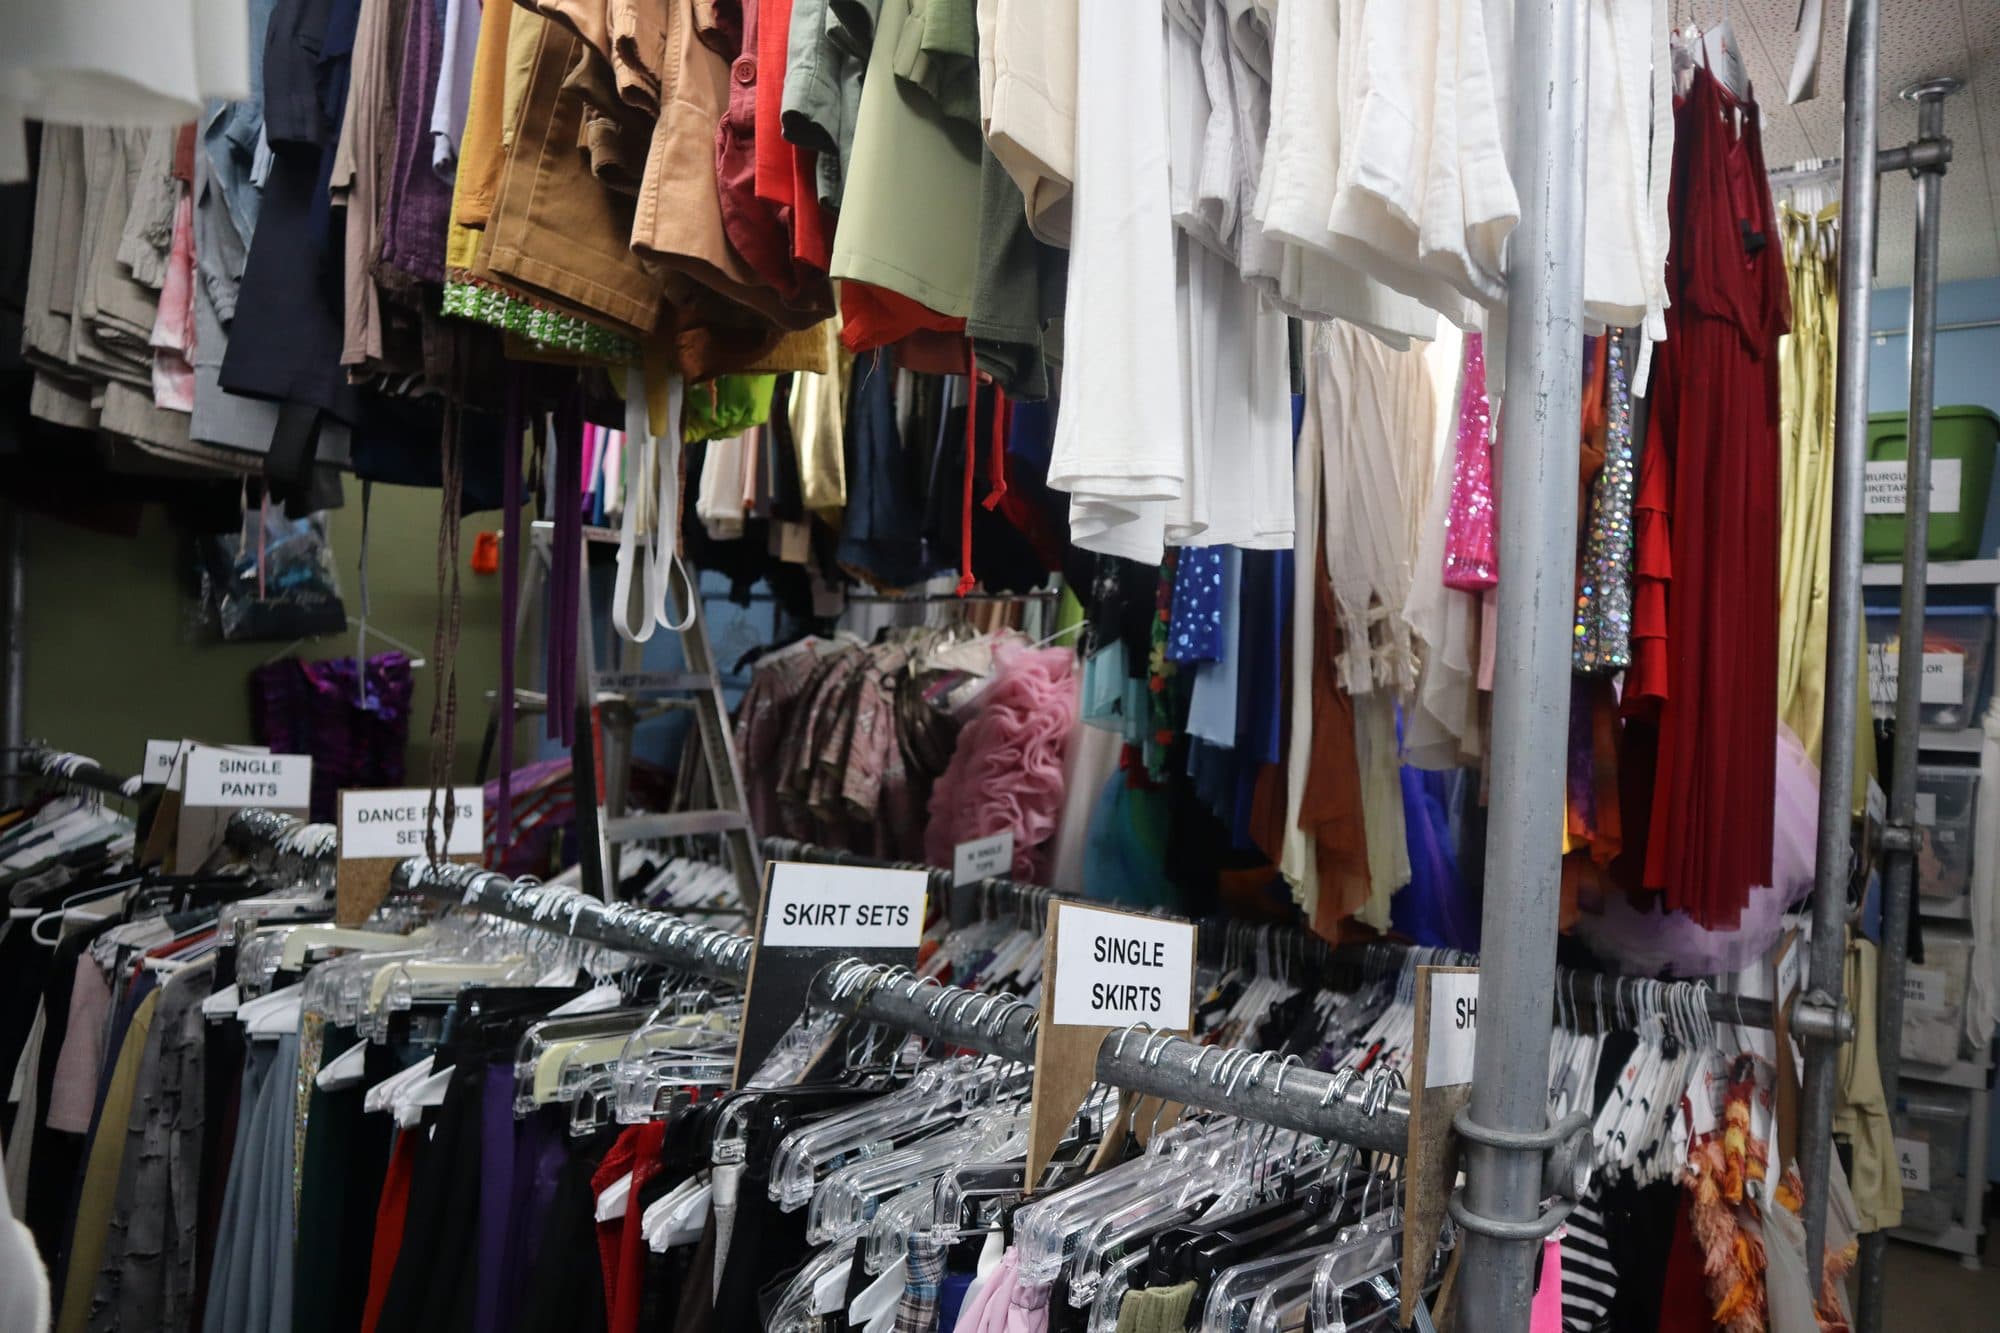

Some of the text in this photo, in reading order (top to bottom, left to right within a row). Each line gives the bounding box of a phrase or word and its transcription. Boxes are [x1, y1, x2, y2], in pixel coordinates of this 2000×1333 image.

[219, 758, 282, 776] SINGLE
[221, 781, 277, 798] PANTS
[357, 804, 473, 824] DANCE PATS
[782, 903, 910, 927] SKIRT SETS
[1093, 935, 1165, 968] SINGLE
[1091, 982, 1162, 1012] SKIRTS
[1455, 997, 1477, 1030] SH
[1901, 1168, 1918, 1180] TS
